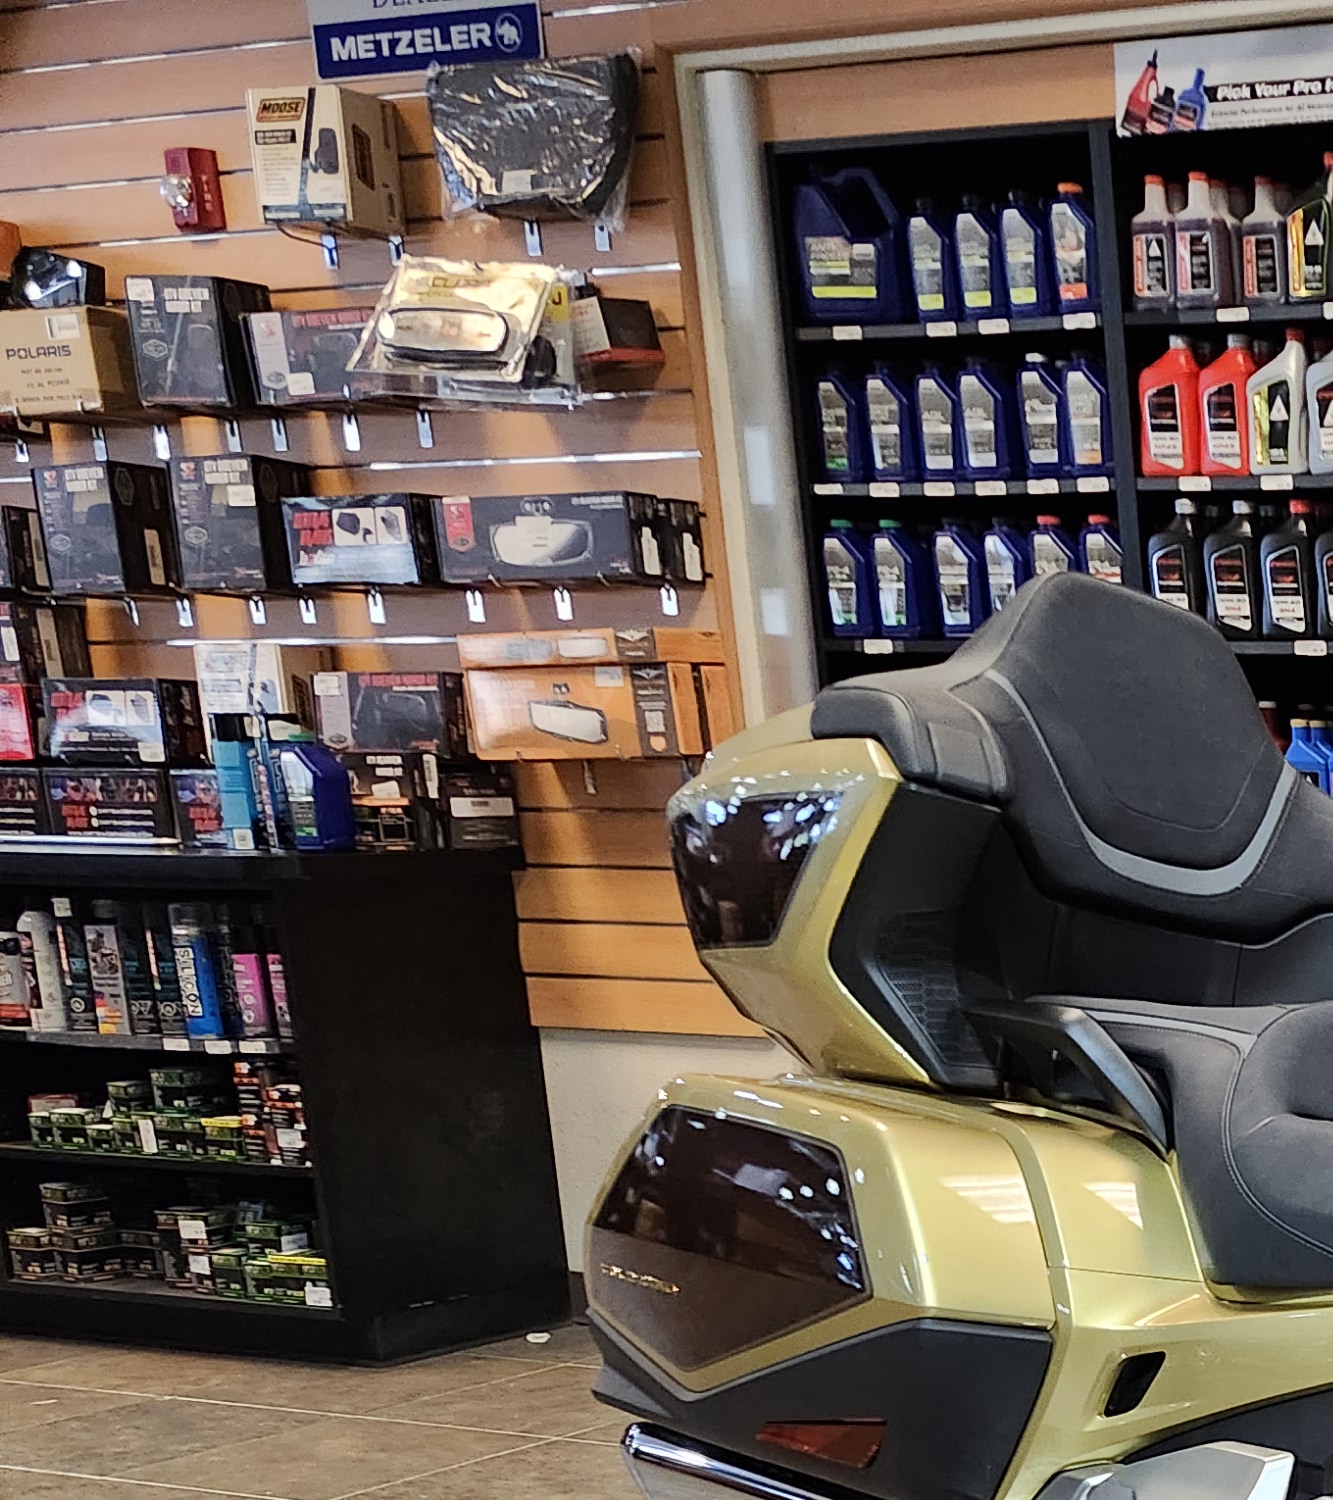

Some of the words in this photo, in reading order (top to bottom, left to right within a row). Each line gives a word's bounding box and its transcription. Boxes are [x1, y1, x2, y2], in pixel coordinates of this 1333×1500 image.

[329, 22, 493, 62] METZELER
[1217, 85, 1251, 100] Pick
[1256, 81, 1290, 98] Your
[1293, 79, 1322, 95] Pro
[260, 100, 303, 115] MOOSE
[6, 344, 72, 361] POLARIS
